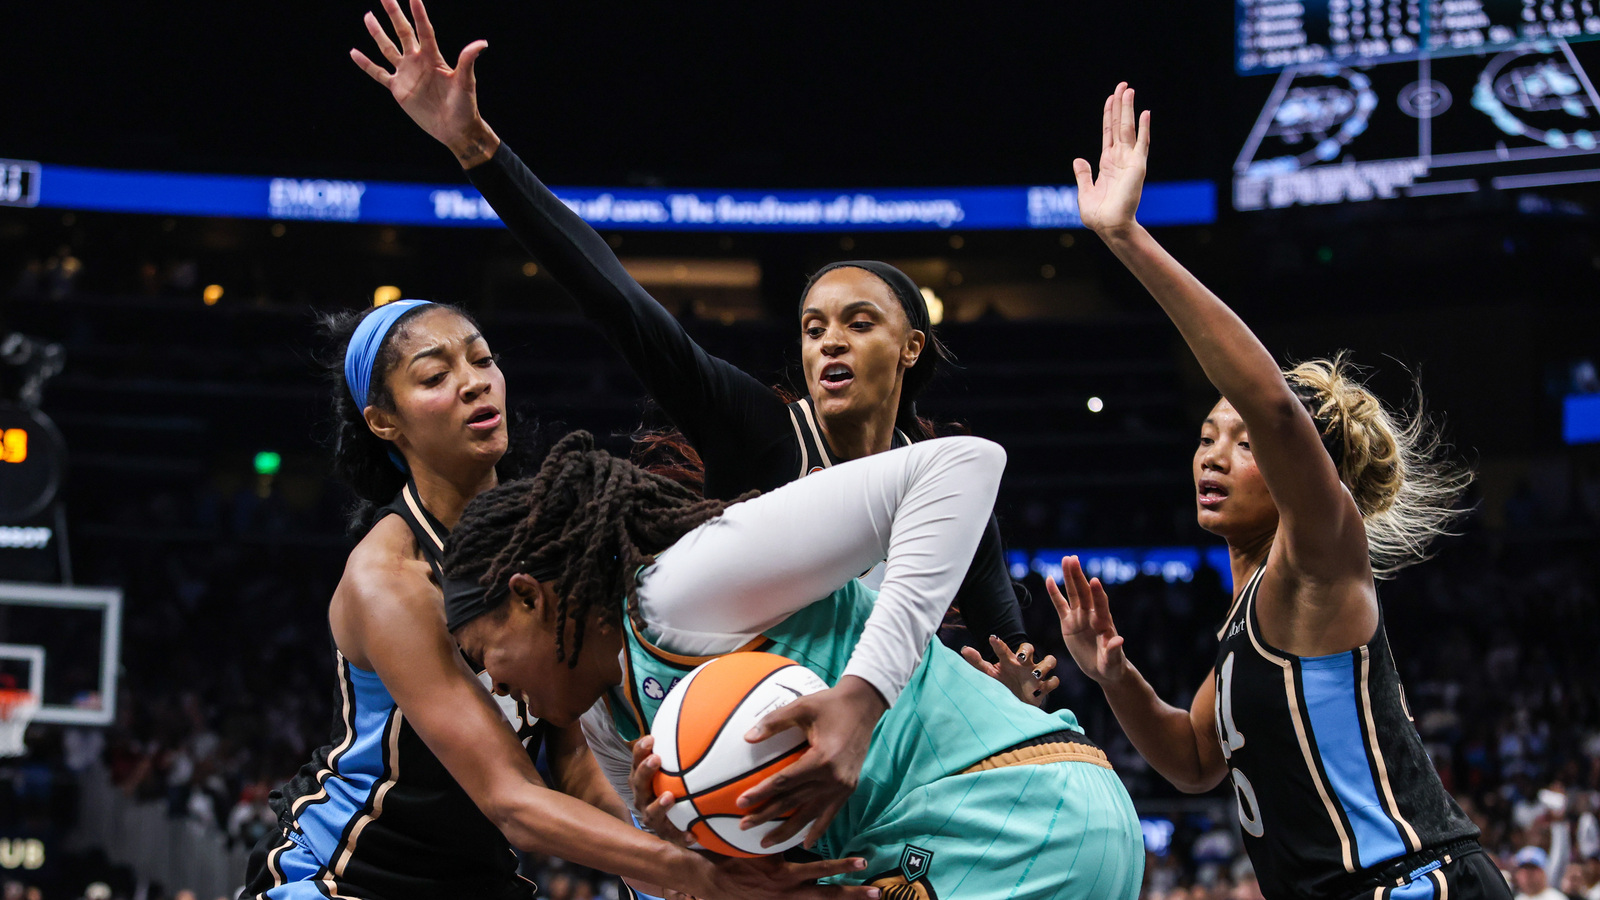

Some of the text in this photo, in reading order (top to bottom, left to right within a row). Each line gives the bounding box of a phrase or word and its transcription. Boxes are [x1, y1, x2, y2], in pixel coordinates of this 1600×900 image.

[269, 178, 366, 209] EMORY
[431, 190, 477, 219] The
[668, 194, 714, 223] The
[715, 195, 822, 224] forefront
[909, 855, 922, 867] M
